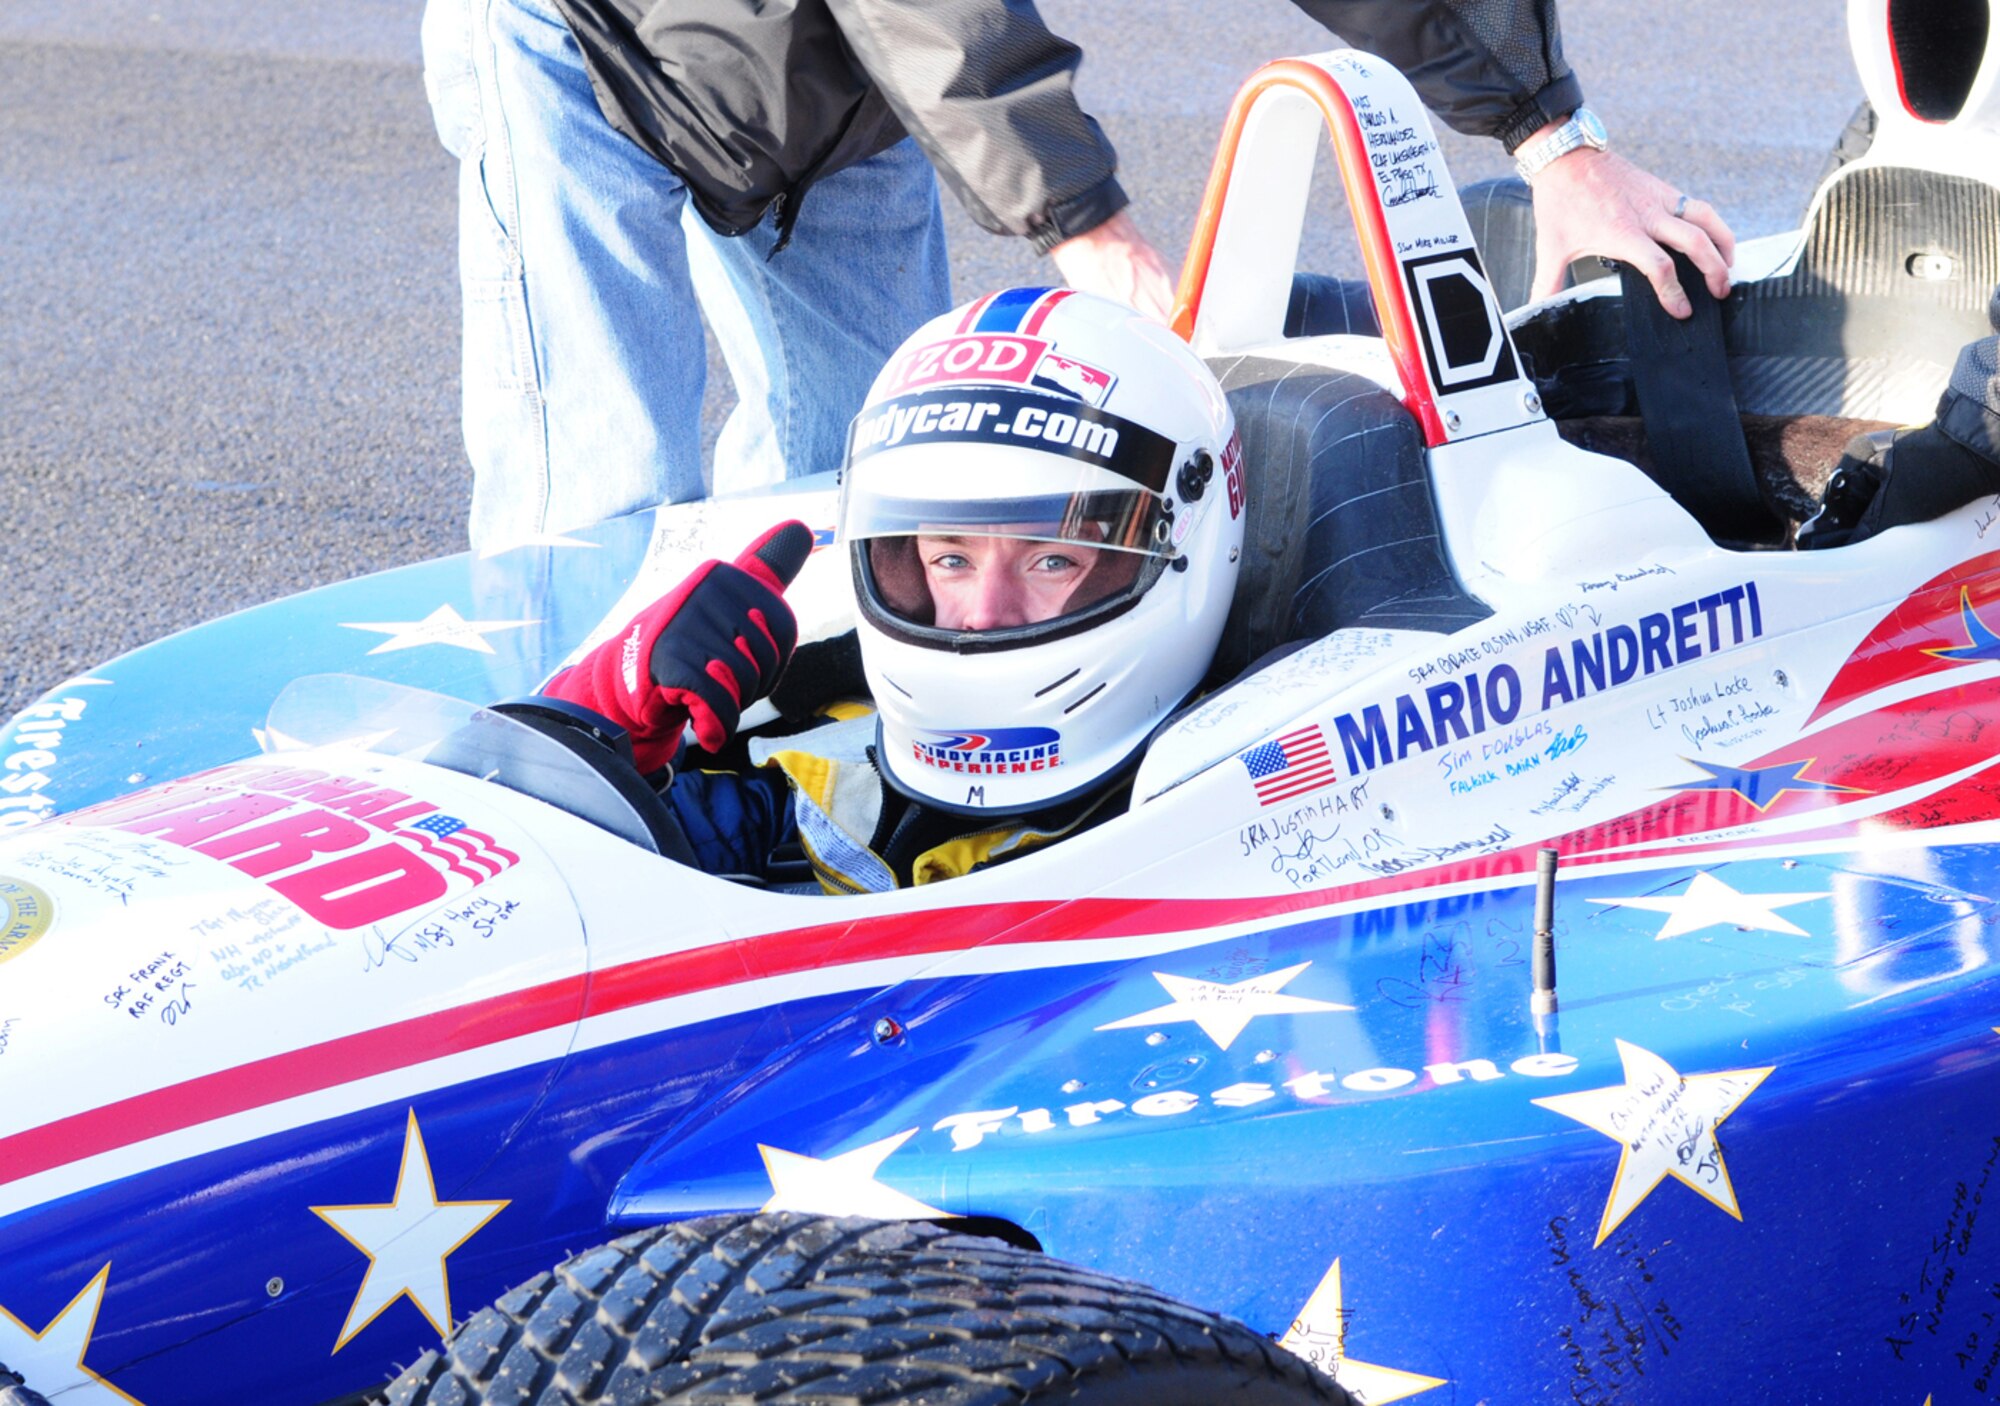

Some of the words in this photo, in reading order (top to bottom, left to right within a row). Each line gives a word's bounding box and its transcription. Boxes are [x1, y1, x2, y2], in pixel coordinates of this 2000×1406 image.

[887, 340, 1028, 393] IZOD
[851, 402, 1119, 458] indycar.com
[1333, 662, 1524, 778] MARIO
[1541, 581, 1763, 711] ANDRETTI
[1715, 675, 1752, 698] Locke
[913, 750, 1061, 775] EXPERIENCE
[928, 746, 973, 763] INDY
[979, 743, 1060, 764] RACING
[965, 785, 985, 806] M
[128, 992, 154, 1019] RAF
[154, 961, 192, 993] REGT
[129, 951, 177, 984] FRANK
[932, 1051, 1580, 1152] Firestone
[1927, 1265, 1956, 1336] NORTH
